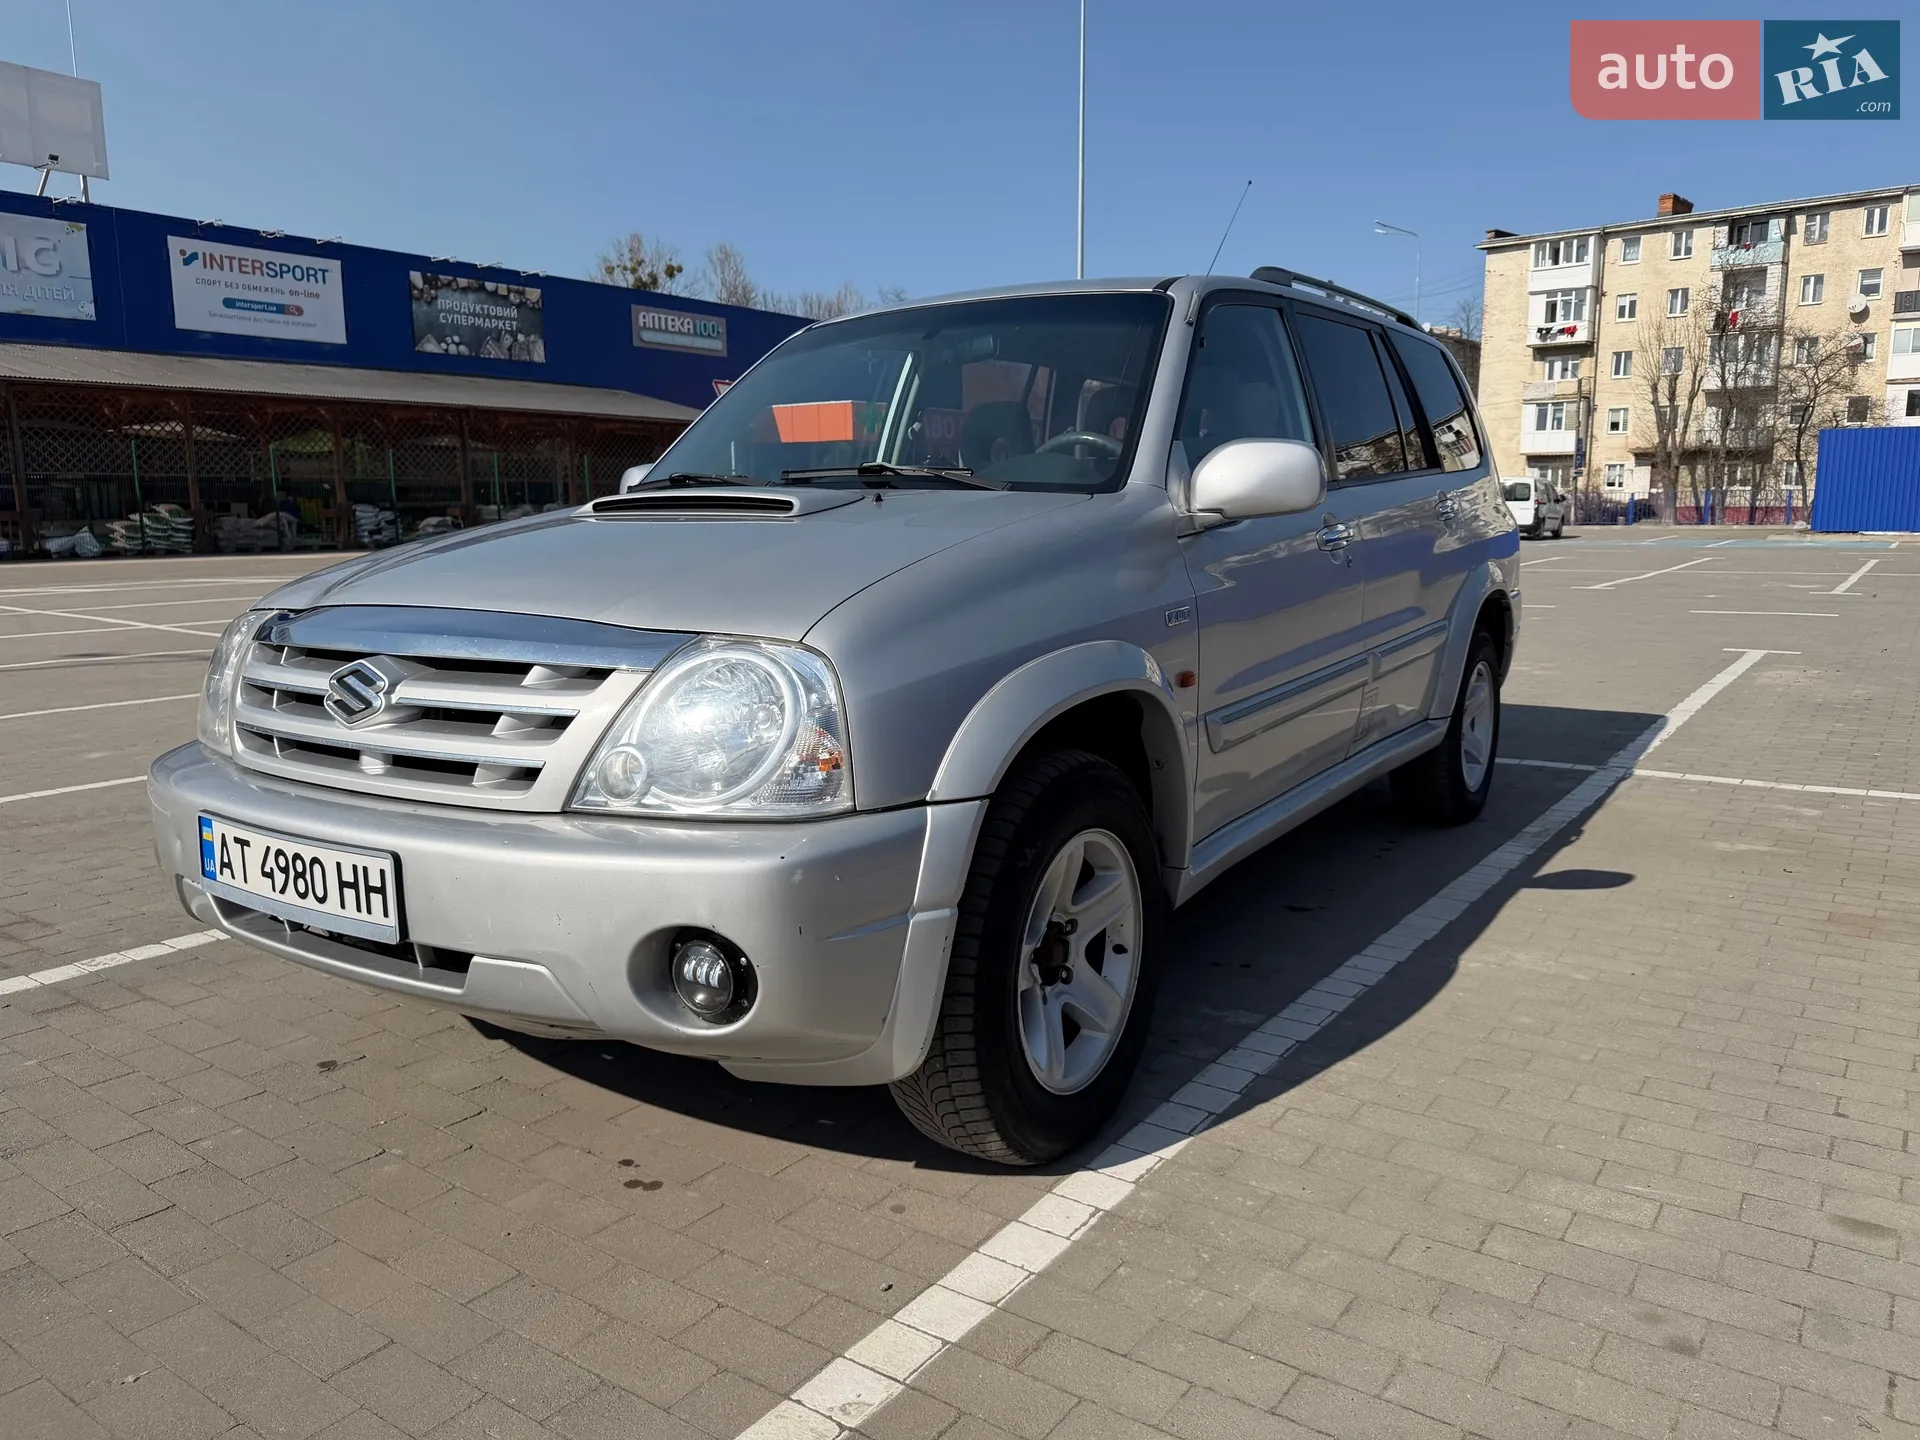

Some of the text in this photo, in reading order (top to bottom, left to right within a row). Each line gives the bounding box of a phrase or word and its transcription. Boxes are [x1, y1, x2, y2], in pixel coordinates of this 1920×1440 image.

[202, 251, 329, 285] INTERSPORT
[23, 284, 75, 302] ДІТЕЙ
[195, 277, 320, 300] СПОРТ БЕЗ ОБМЕЖЕНЬ on-line
[235, 300, 277, 311] intersport.ua
[438, 299, 518, 319] ПРОДУКТОВИЙ
[439, 312, 518, 331] СУПЕРМАРКЕТ
[638, 311, 693, 334] АПТЕКА
[204, 857, 216, 873] UA
[219, 832, 389, 918] AT 4980 HH
